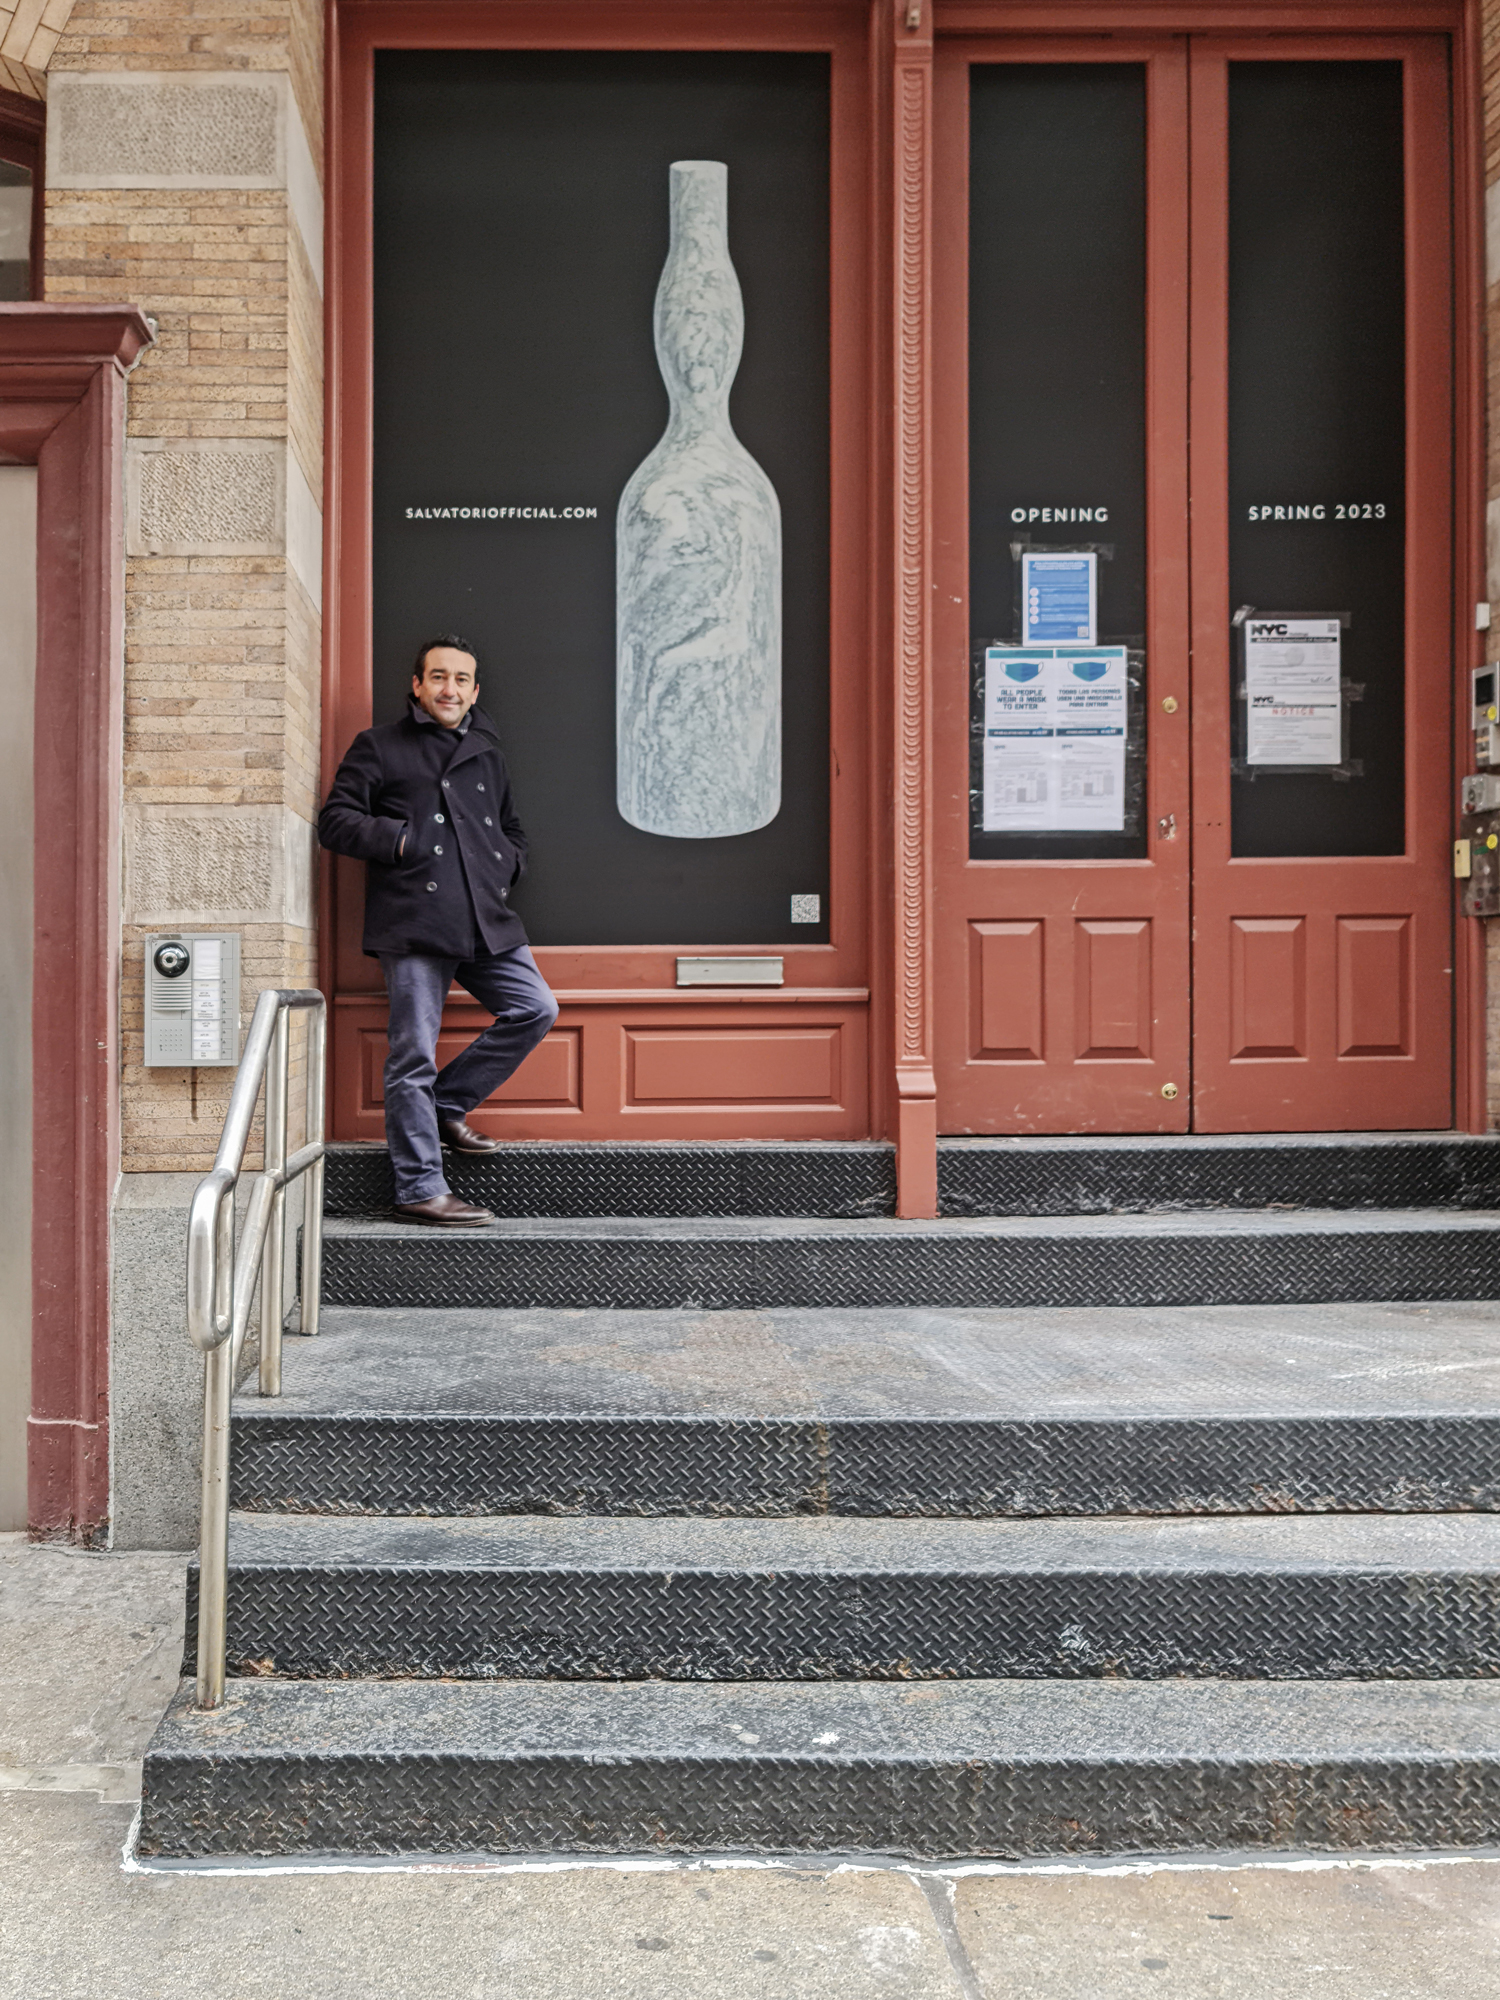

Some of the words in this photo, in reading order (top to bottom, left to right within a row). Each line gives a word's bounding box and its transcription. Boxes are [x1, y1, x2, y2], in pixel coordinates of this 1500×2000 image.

[405, 507, 598, 519] SALVATORIOFFICIAL.COM
[1010, 507, 1109, 523] OPENING
[1248, 505, 1326, 521] SPRING
[1334, 503, 1387, 519] 2023
[1251, 624, 1288, 635] NYC
[1253, 696, 1274, 704] NYC
[1272, 707, 1315, 716] NOTICE
